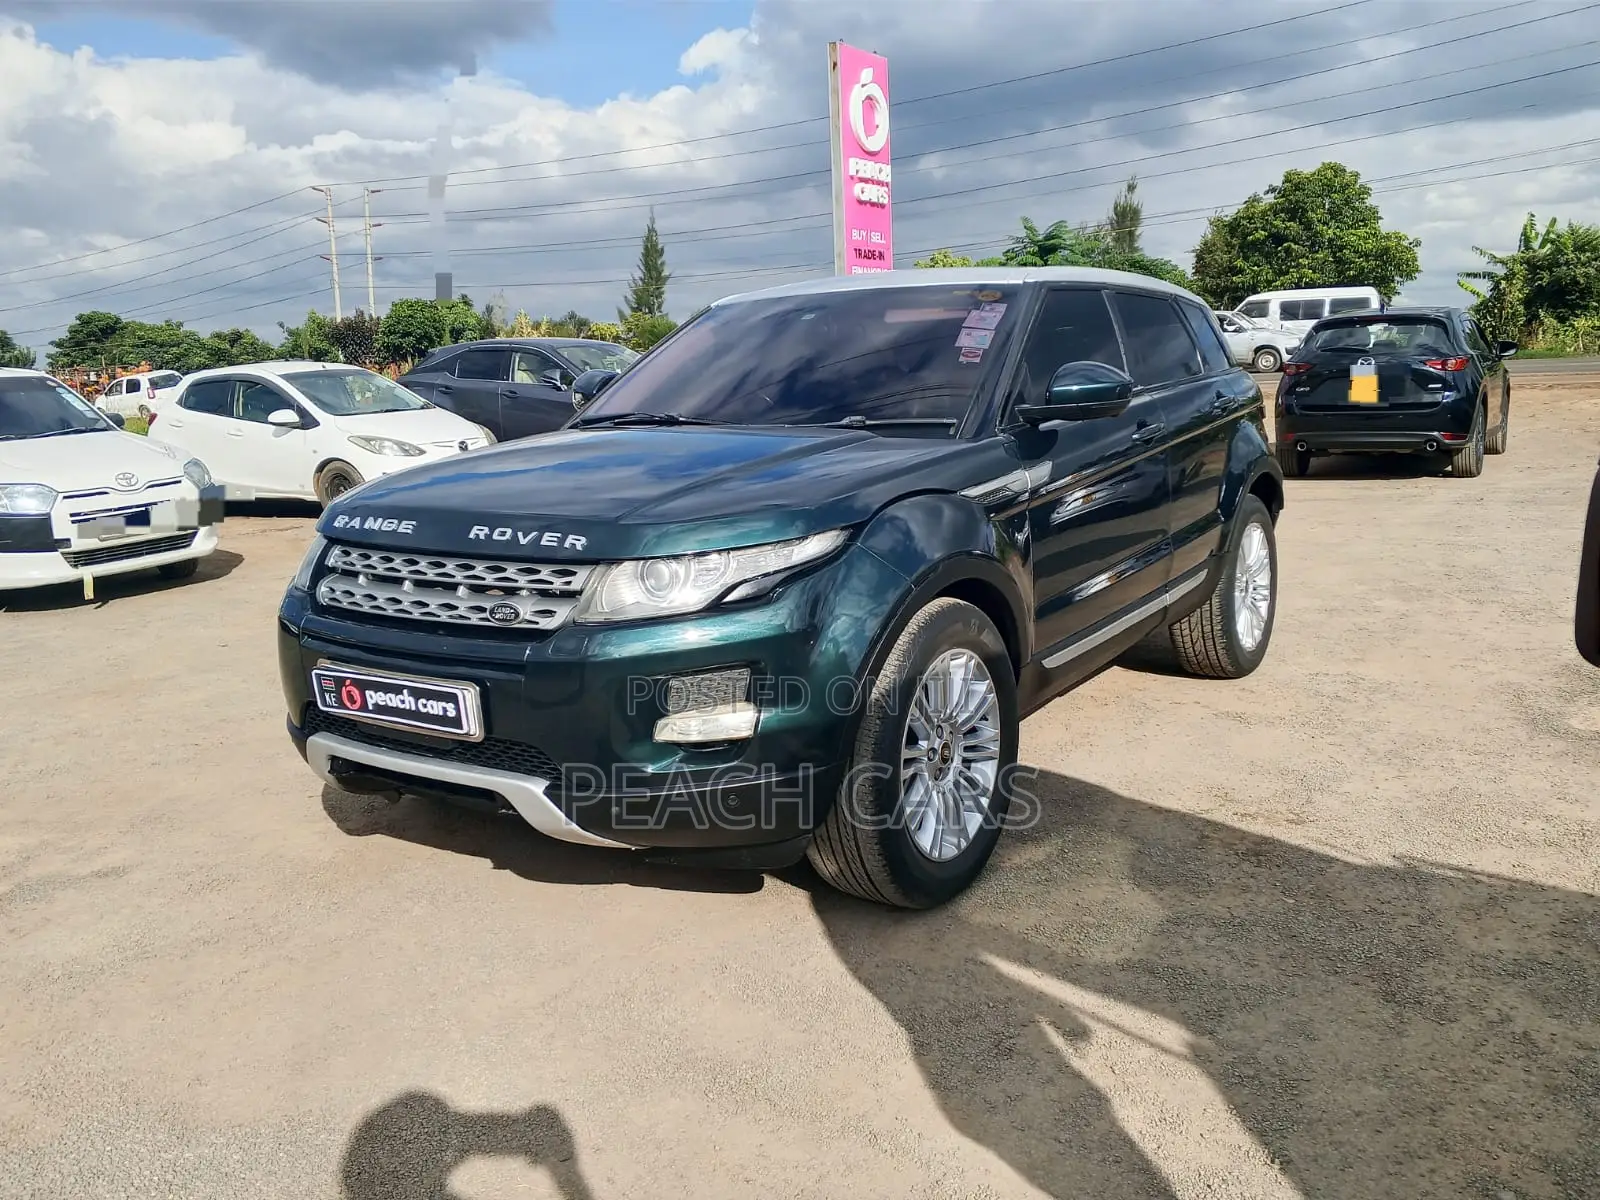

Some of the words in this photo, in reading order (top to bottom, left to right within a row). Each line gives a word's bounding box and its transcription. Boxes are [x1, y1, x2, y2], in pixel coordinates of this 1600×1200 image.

[854, 182, 889, 204] CARS
[851, 229, 867, 241] BUY
[870, 231, 886, 244] SELL
[853, 248, 886, 261] TRADE-IN
[851, 265, 892, 275] FINAN
[333, 514, 417, 535] RANGE
[468, 525, 588, 551] ROVER
[324, 692, 337, 707] KE
[365, 688, 416, 711] peach
[417, 699, 457, 718] cars
